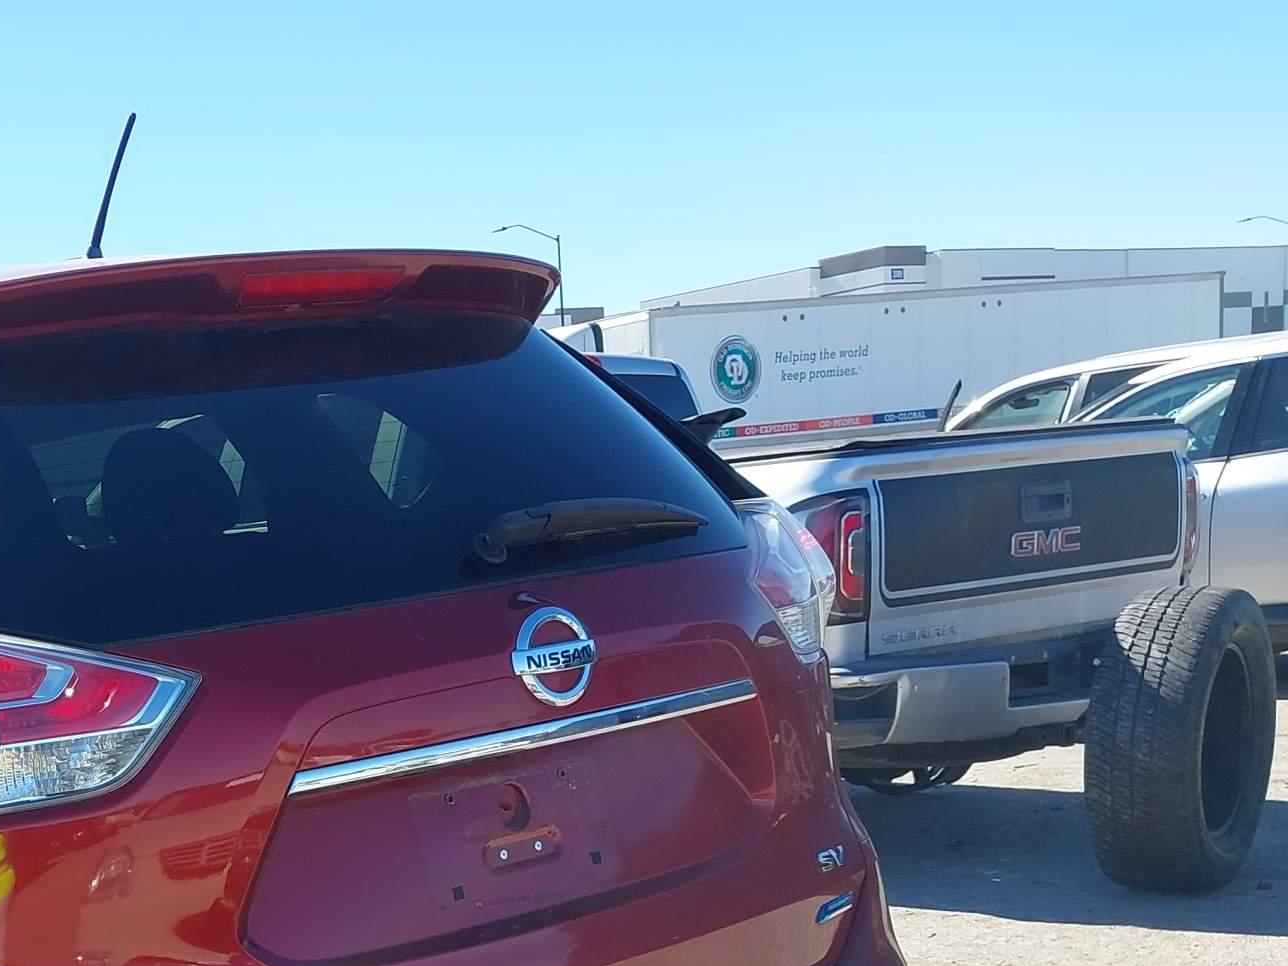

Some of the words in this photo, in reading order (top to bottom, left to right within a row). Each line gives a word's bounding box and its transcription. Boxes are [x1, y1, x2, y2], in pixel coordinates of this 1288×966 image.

[774, 350, 817, 365] Helping
[819, 347, 836, 360] the
[839, 344, 869, 358] world
[781, 369, 806, 383] keep
[883, 410, 926, 422] OD-GLOBAL
[1011, 526, 1081, 558] GMC
[525, 643, 593, 669] NISSAN
[817, 845, 844, 872] SV
